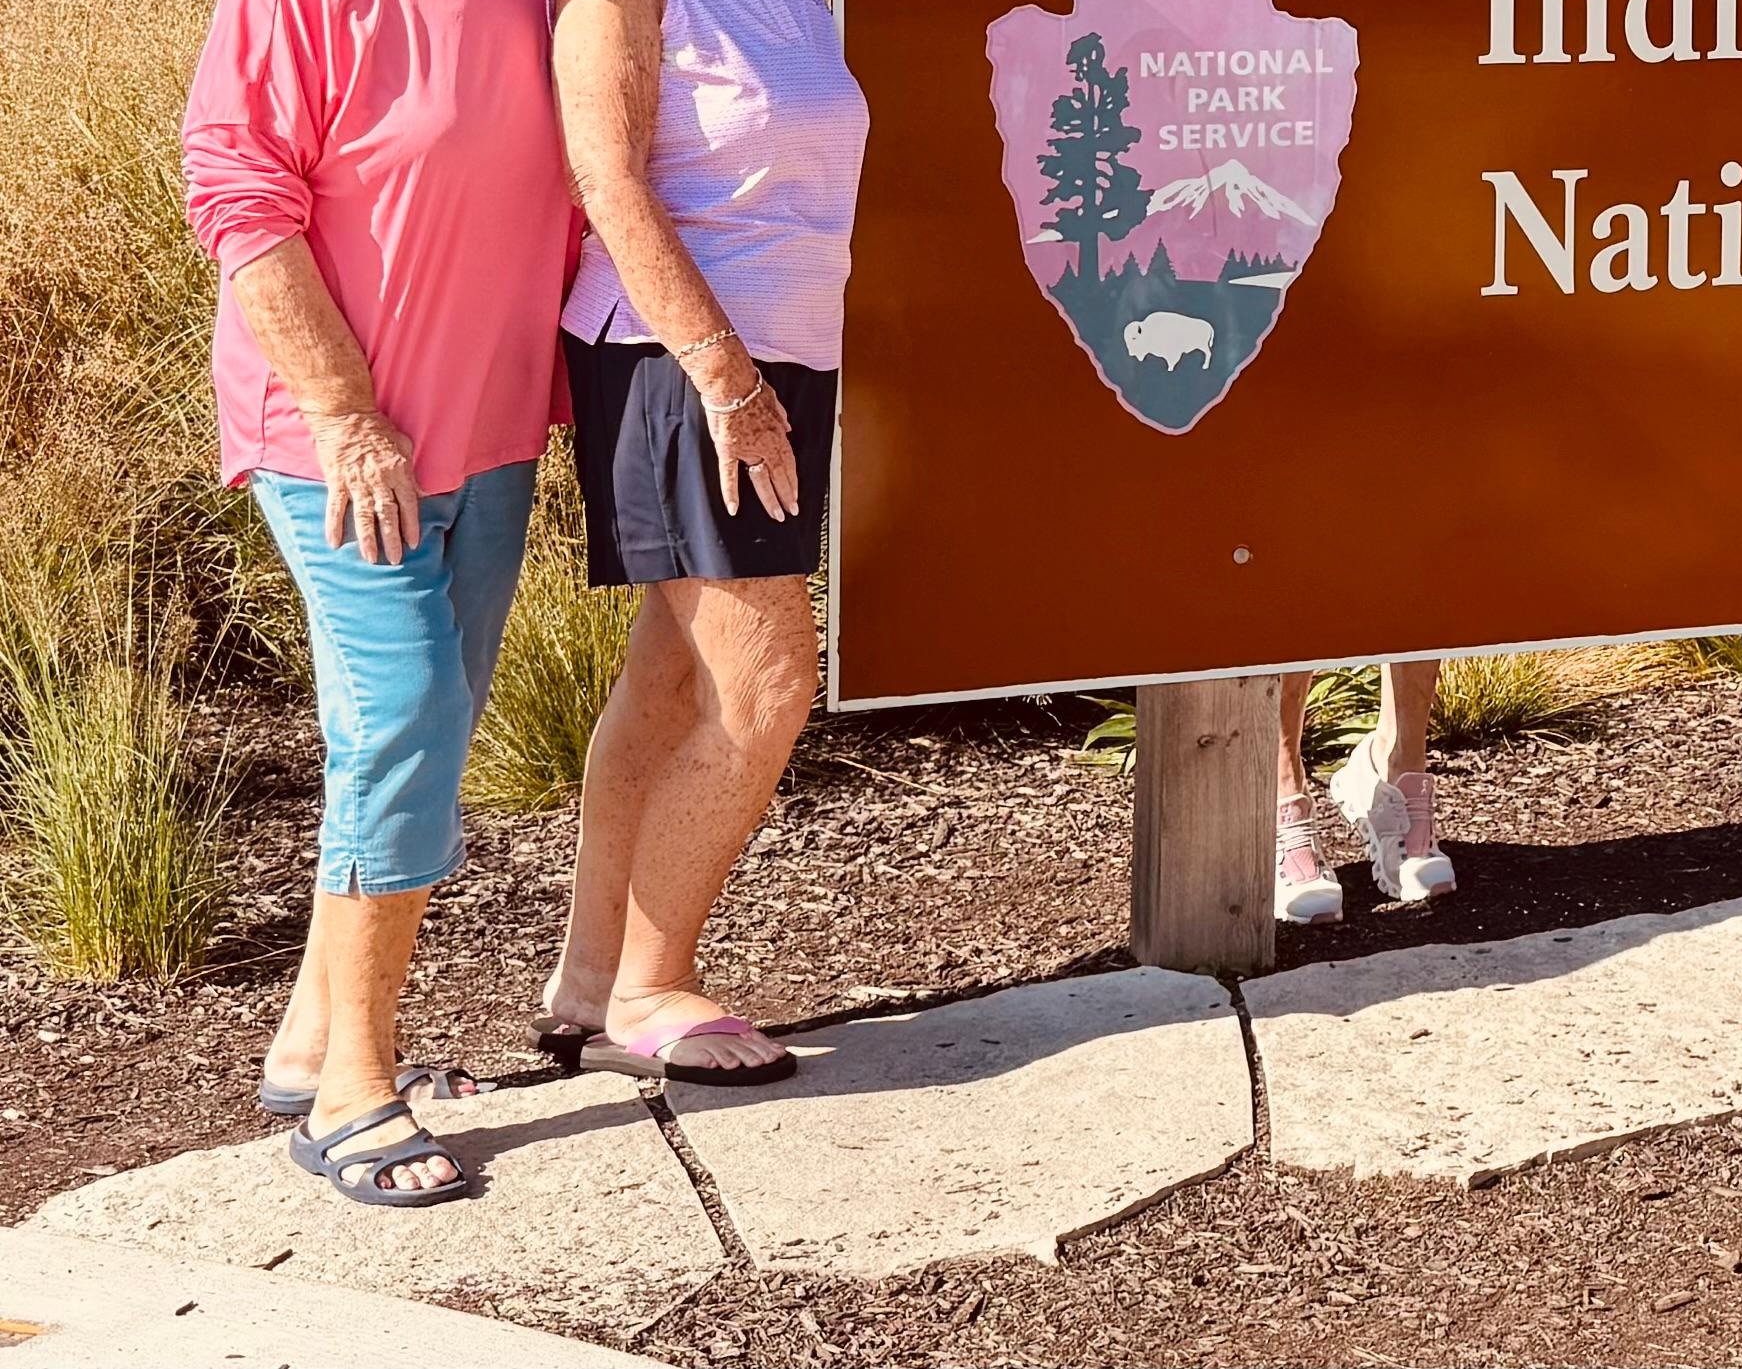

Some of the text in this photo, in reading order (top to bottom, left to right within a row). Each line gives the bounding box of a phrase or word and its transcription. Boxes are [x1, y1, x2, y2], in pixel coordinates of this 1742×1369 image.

[1140, 48, 1334, 78] NATIONAL
[1187, 85, 1286, 113] PARK
[1158, 120, 1314, 151] SERVICE
